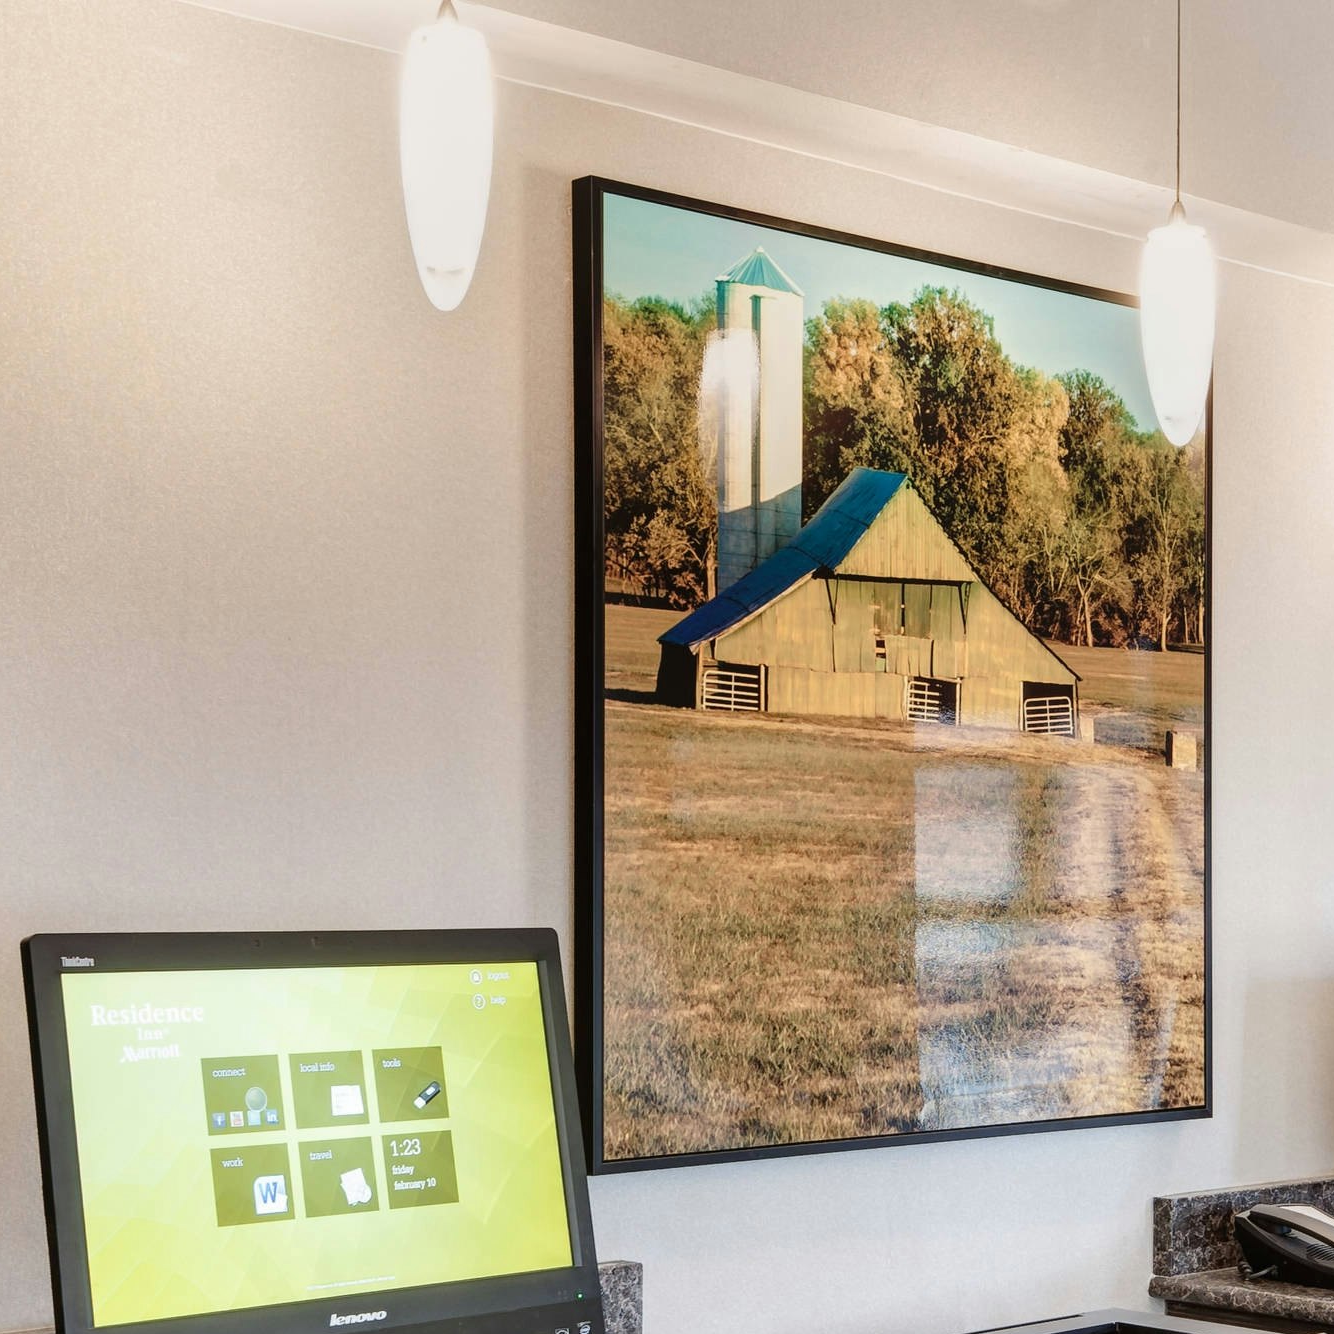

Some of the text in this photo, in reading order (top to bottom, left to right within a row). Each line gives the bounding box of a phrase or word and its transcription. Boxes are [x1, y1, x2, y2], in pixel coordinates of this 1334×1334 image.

[90, 1003, 205, 1026] Residence
[300, 1062, 335, 1072] local info
[382, 1058, 401, 1068] tools
[212, 1068, 246, 1078] connect
[390, 1139, 421, 1157] 1:23
[309, 1150, 333, 1160] travel
[222, 1157, 244, 1168] work
[392, 1165, 415, 1176] friday
[427, 1177, 437, 1187] 10
[259, 1182, 278, 1204] W
[329, 1310, 387, 1327] lenovo
